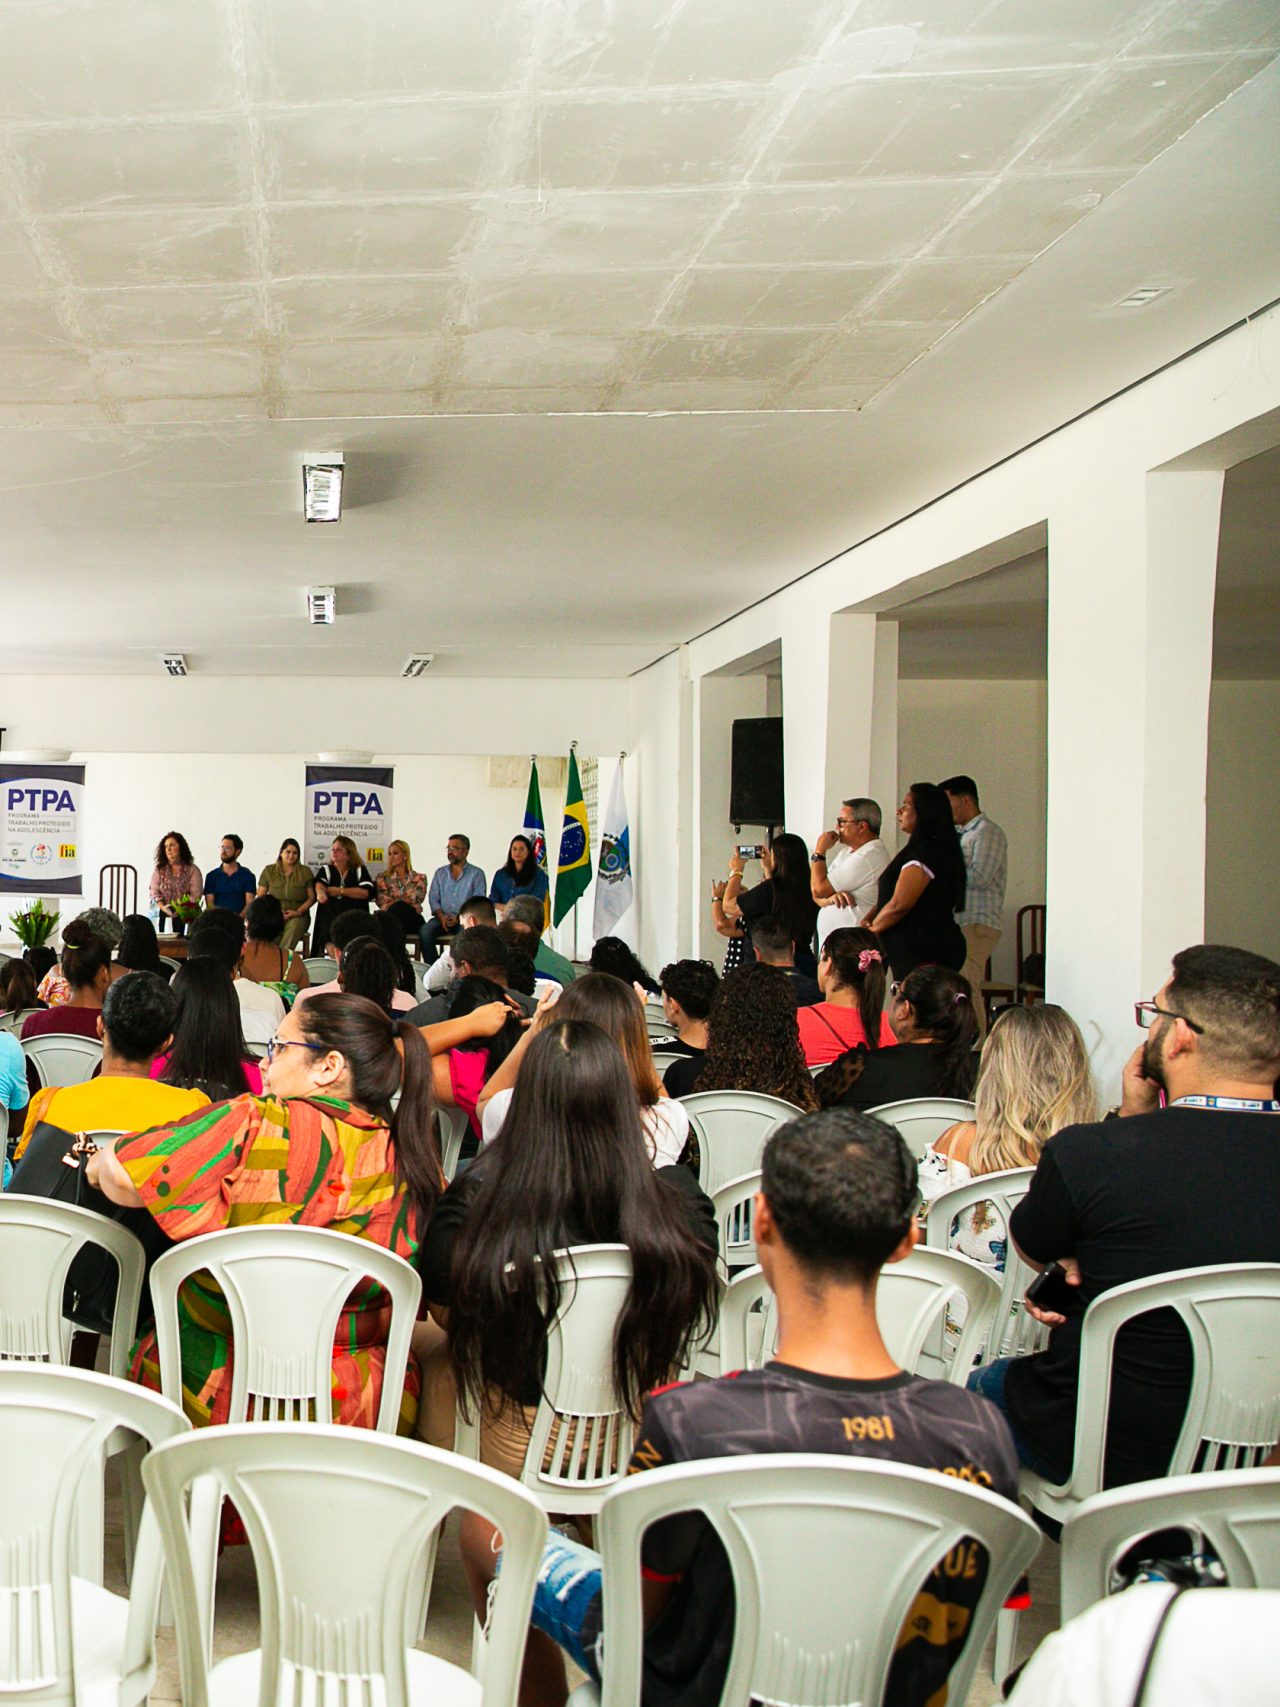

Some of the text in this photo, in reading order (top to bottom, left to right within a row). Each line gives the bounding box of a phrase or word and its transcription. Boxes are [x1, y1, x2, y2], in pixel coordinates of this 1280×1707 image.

[8, 788, 76, 812] PTPA
[313, 791, 384, 815] PTPA
[60, 844, 75, 857] fia
[367, 848, 383, 861] fia
[841, 1416, 895, 1441] 1981
